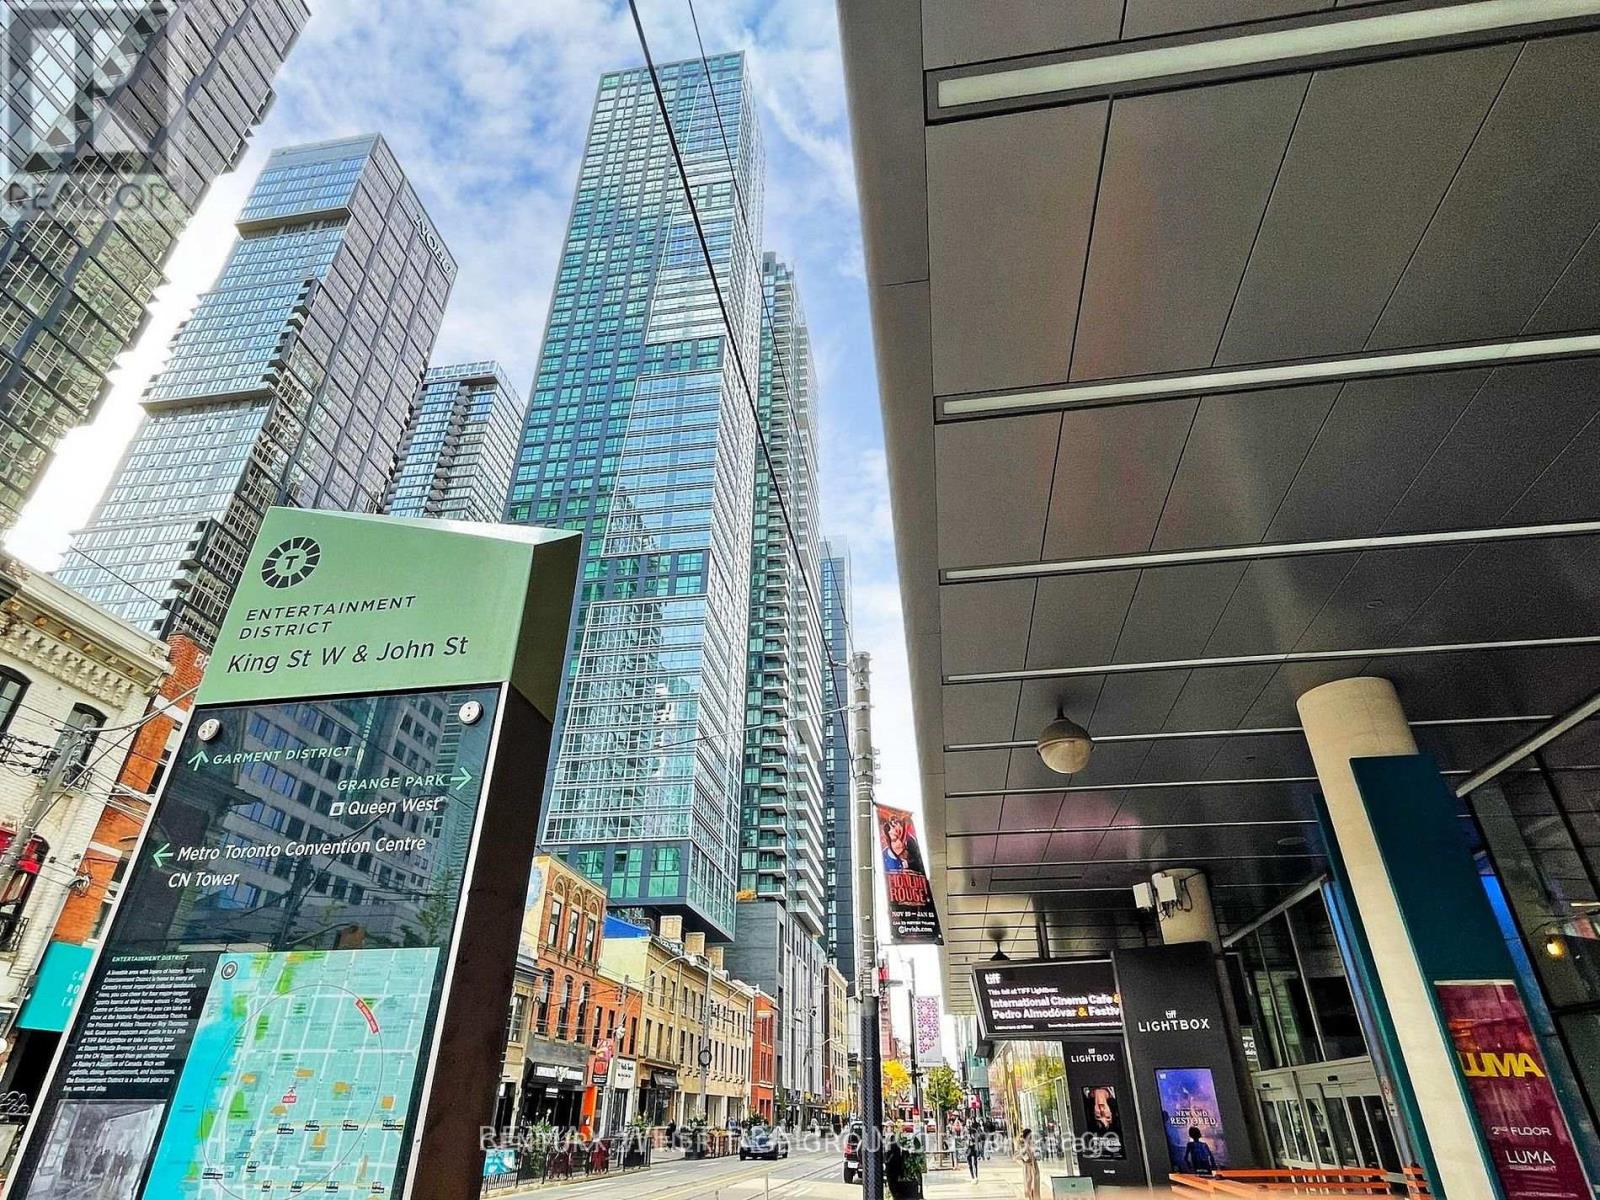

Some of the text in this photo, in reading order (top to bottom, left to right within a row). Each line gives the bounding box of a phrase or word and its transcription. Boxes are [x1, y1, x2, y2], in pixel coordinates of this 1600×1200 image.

[246, 596, 416, 621] ENTERTAINMENT
[239, 621, 332, 640] DISTRICT
[227, 636, 468, 674] King St W & John St
[213, 747, 352, 765] GARMENT DISTRICT
[338, 774, 445, 792] GRANGE PARK
[348, 798, 440, 817] Queen West
[177, 837, 426, 862] Metro Toronto Convention Centre
[167, 871, 239, 888] CN Tower
[985, 973, 1001, 984] tiff
[990, 996, 1050, 1008] International
[1050, 995, 1088, 1006] Cinema
[993, 1008, 1022, 1020] Pedro
[1023, 1006, 1077, 1019] Almodóvar
[1077, 1006, 1088, 1017] &
[1165, 1010, 1177, 1019] tiff
[1138, 1018, 1210, 1032] LIGHTBOX
[1071, 1053, 1116, 1063] LIGHTBOX
[1457, 1051, 1545, 1078] LUMA
[1170, 1117, 1216, 1125] RESTORED
[1511, 1126, 1552, 1136] FLOOR
[1505, 1150, 1556, 1165] LUMA
